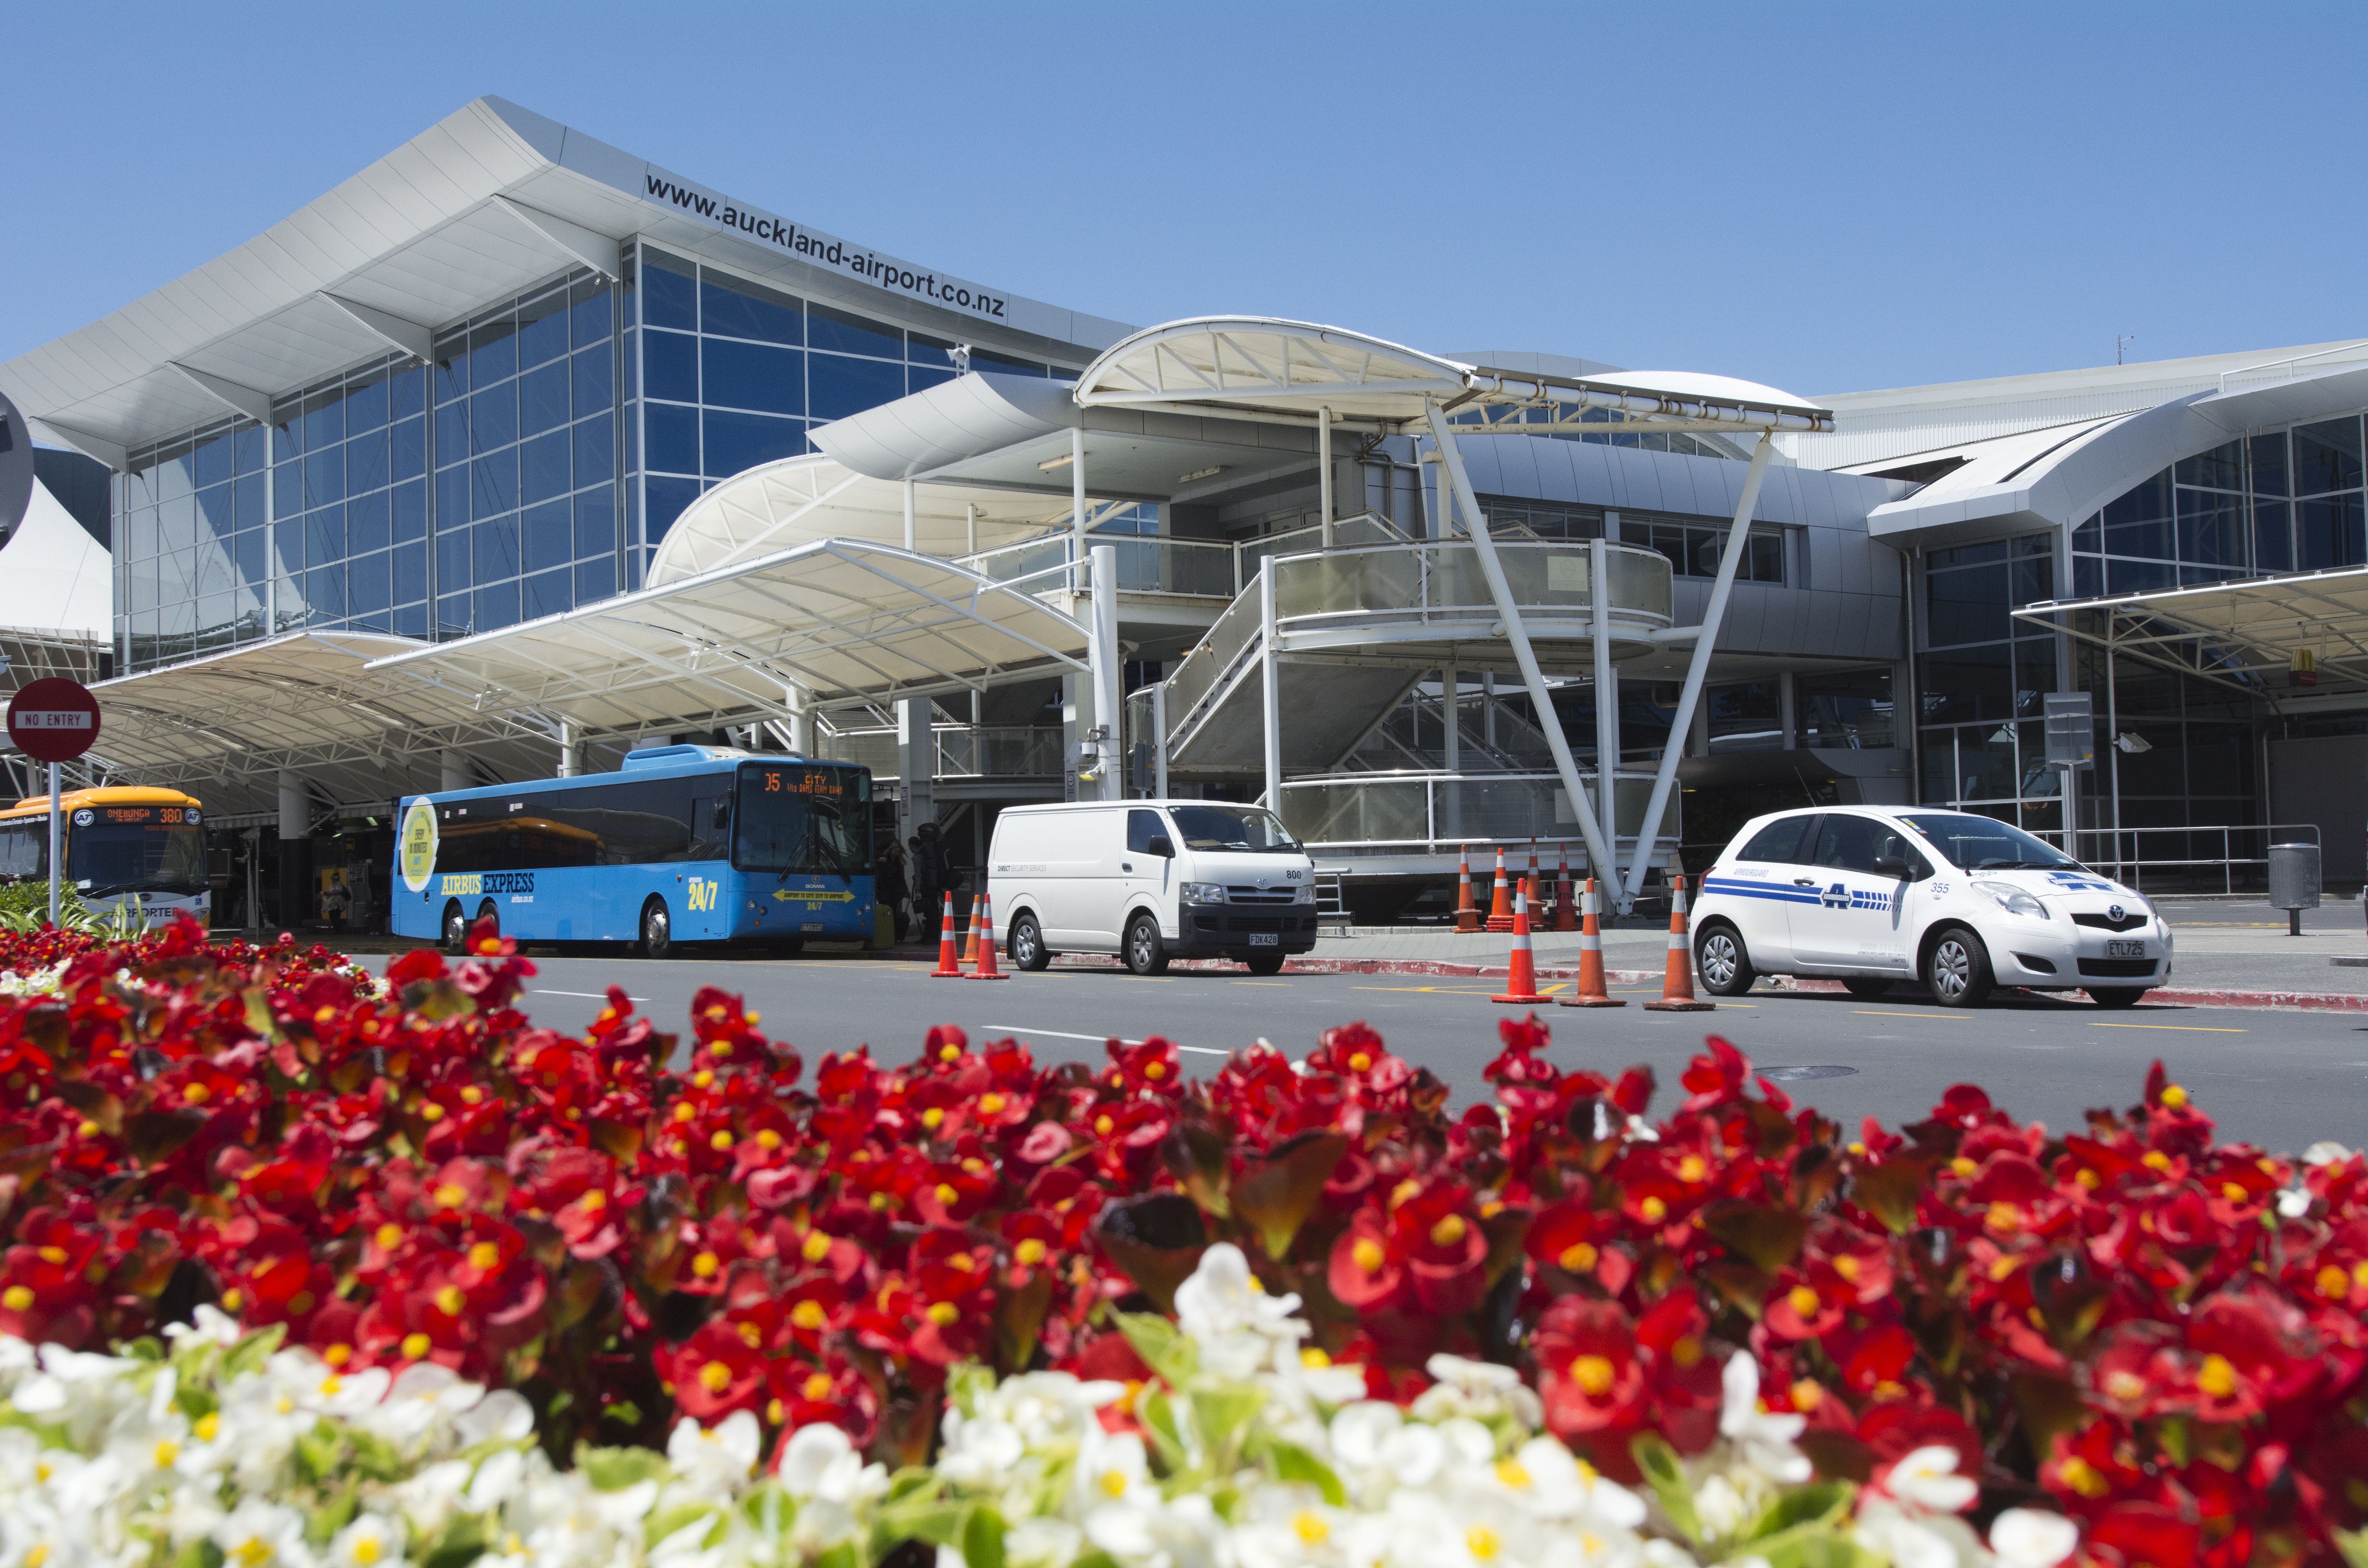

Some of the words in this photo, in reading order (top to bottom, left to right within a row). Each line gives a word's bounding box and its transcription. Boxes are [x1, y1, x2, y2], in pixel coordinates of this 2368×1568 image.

[646, 174, 1005, 318] www.auckland-airport.co.nz
[25, 714, 38, 725] NO
[48, 714, 81, 725] ENTRY
[108, 808, 150, 818] ONEHUNGA
[160, 808, 182, 822] 380
[1286, 870, 1301, 879] 800
[1733, 868, 1769, 877] ARMOURGUARD
[441, 874, 481, 895] AIRBUS
[483, 872, 534, 894] EXPRESS
[1931, 882, 1949, 893] 355
[688, 881, 717, 912] 24/7
[807, 902, 823, 911] 24/7
[1251, 935, 1277, 943] FDK428
[2109, 943, 2143, 955] ETL725
